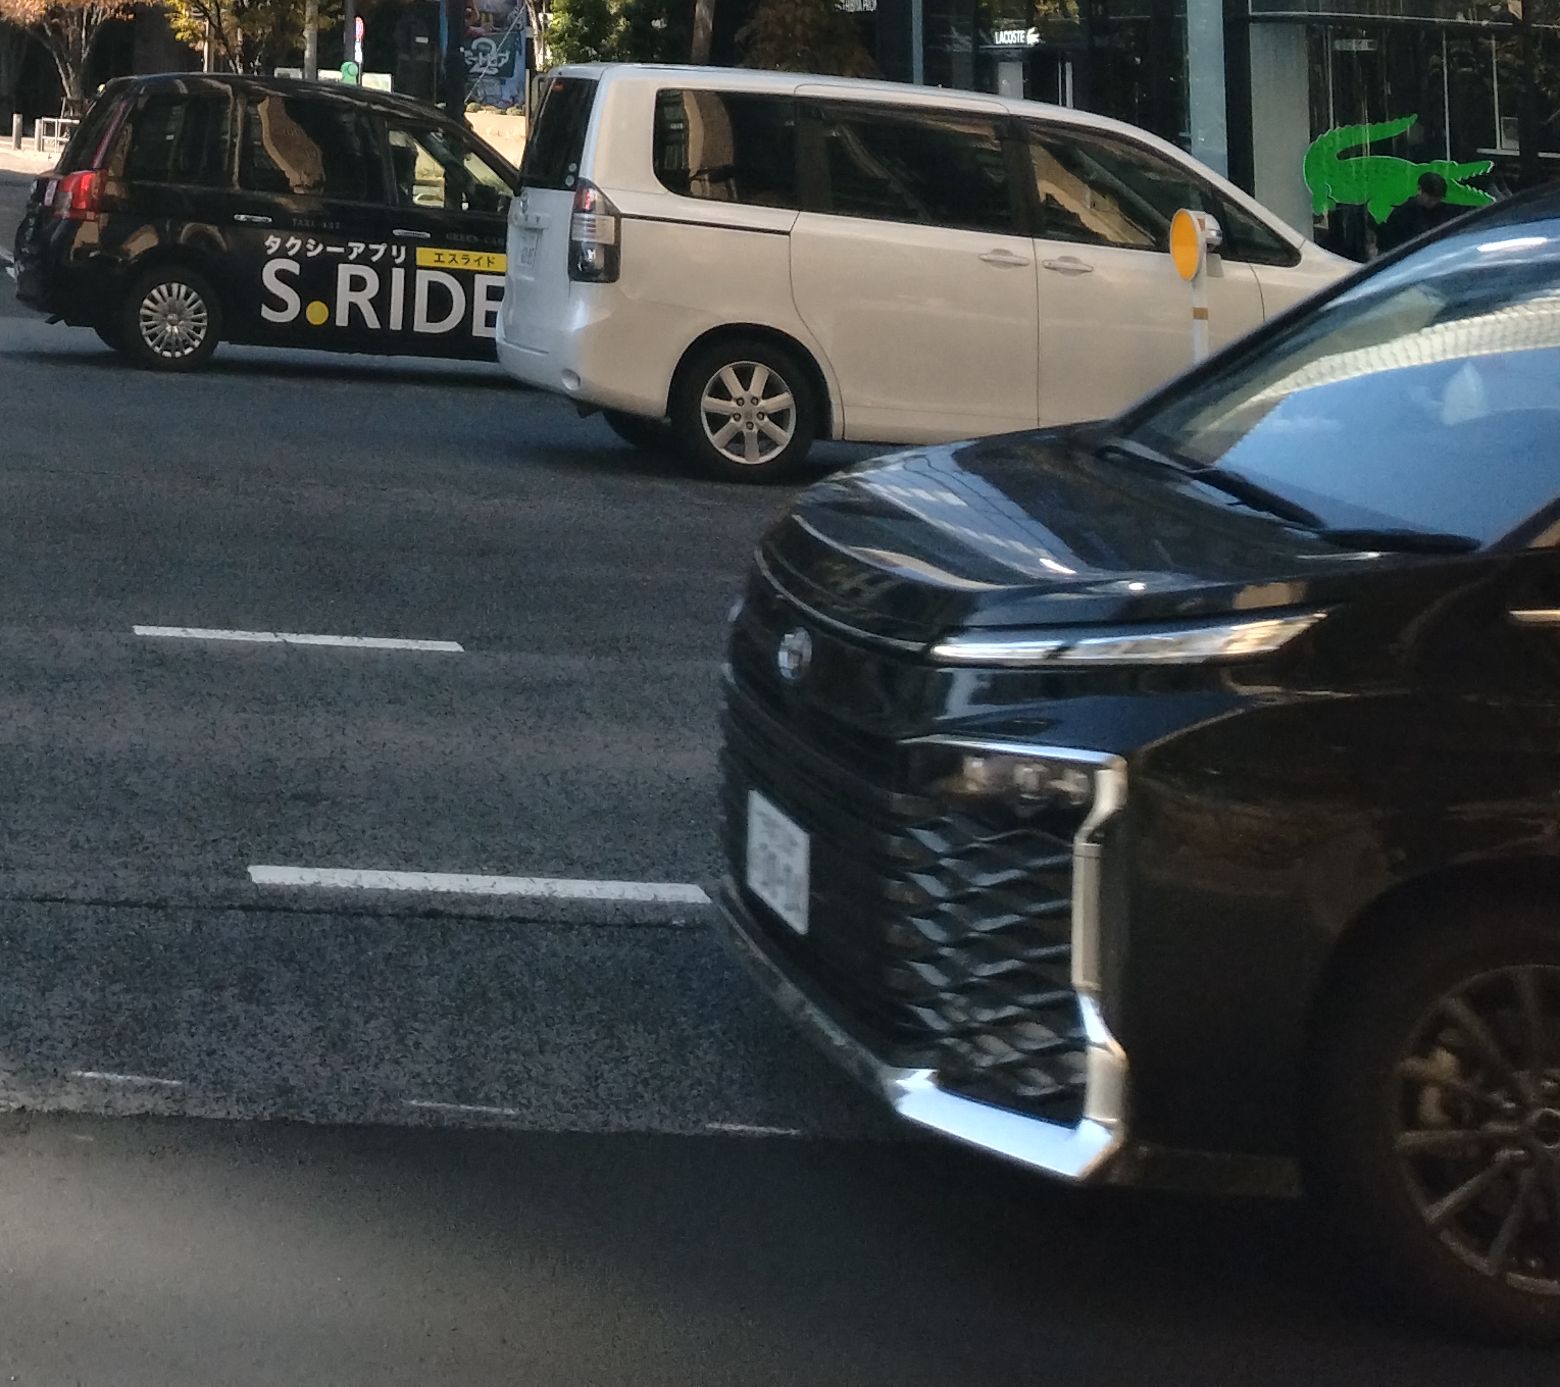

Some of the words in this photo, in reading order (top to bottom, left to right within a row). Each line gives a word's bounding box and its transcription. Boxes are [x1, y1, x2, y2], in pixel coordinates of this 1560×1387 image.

[994, 29, 1026, 45] LACOSTE
[264, 234, 407, 264] タクシーアプリ
[433, 251, 496, 268] エスライド
[260, 258, 508, 338] S.RIDE
